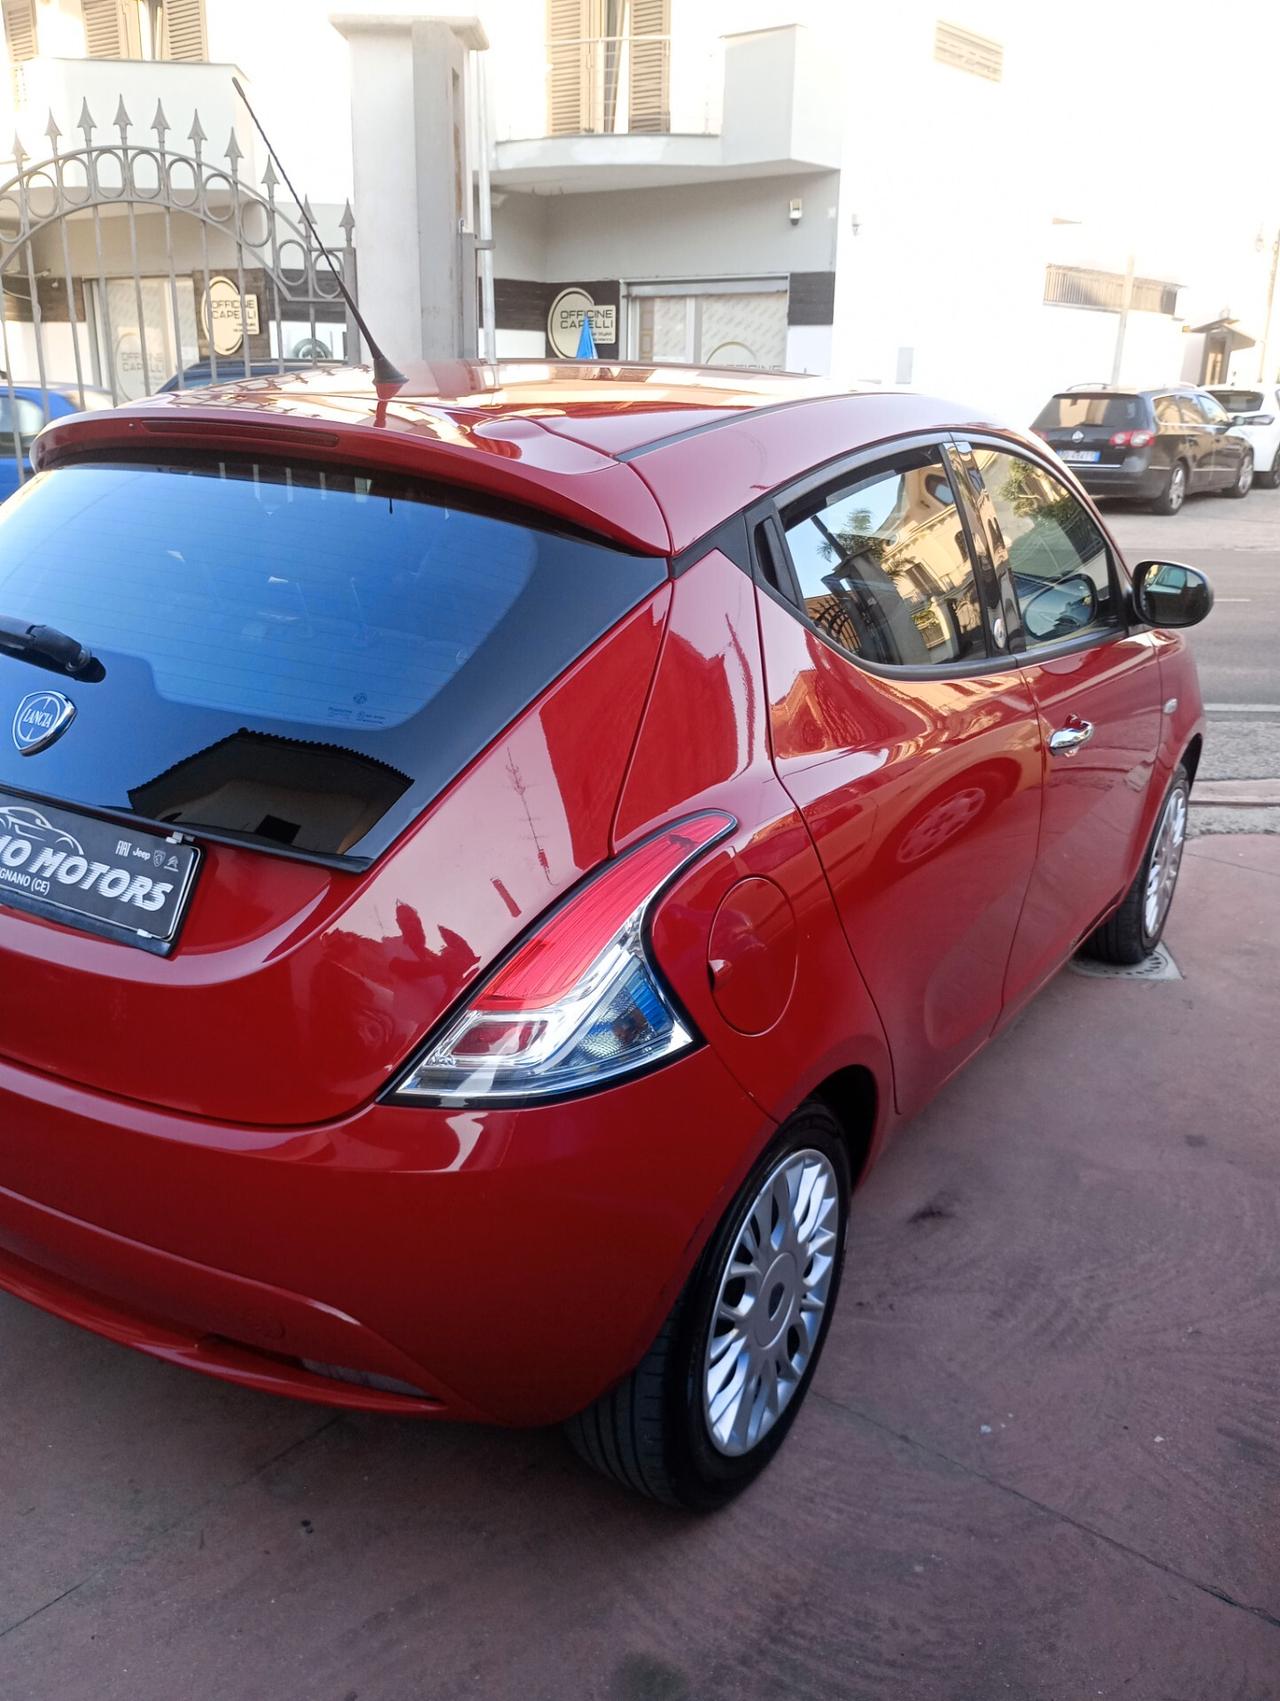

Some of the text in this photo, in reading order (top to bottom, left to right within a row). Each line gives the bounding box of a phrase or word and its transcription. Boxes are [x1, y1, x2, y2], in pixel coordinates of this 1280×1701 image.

[212, 310, 257, 319] CAPELI
[23, 708, 53, 728] LANCIA
[115, 840, 151, 861] FIAT Jeep
[27, 847, 174, 912] MOTORS
[31, 877, 50, 896] (CE)
